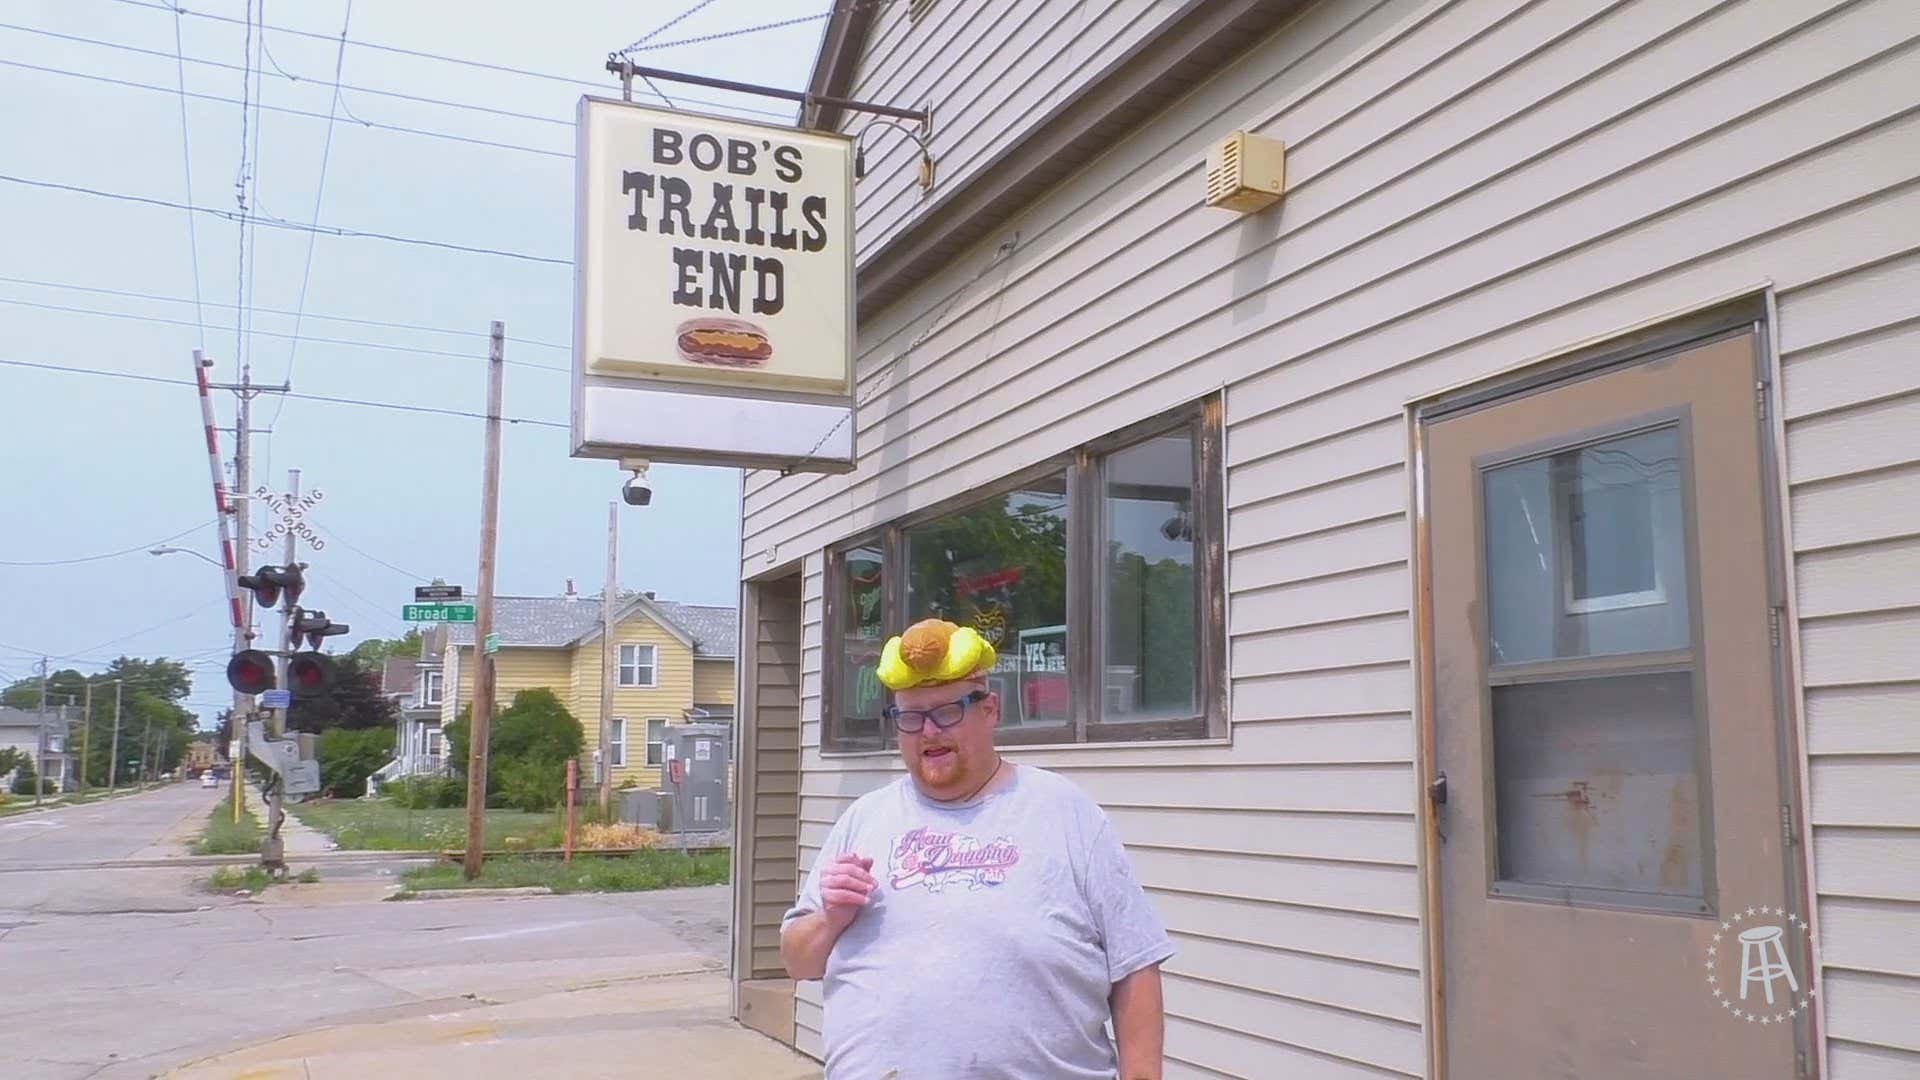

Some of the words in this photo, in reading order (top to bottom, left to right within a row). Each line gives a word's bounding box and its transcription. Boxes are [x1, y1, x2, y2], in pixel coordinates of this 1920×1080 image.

[653, 128, 803, 183] BOB'S
[622, 170, 828, 253] TRAILS
[672, 247, 784, 316] END
[257, 489, 323, 549] CROSSING
[409, 606, 448, 620] Broad
[1025, 642, 1046, 673] YES
